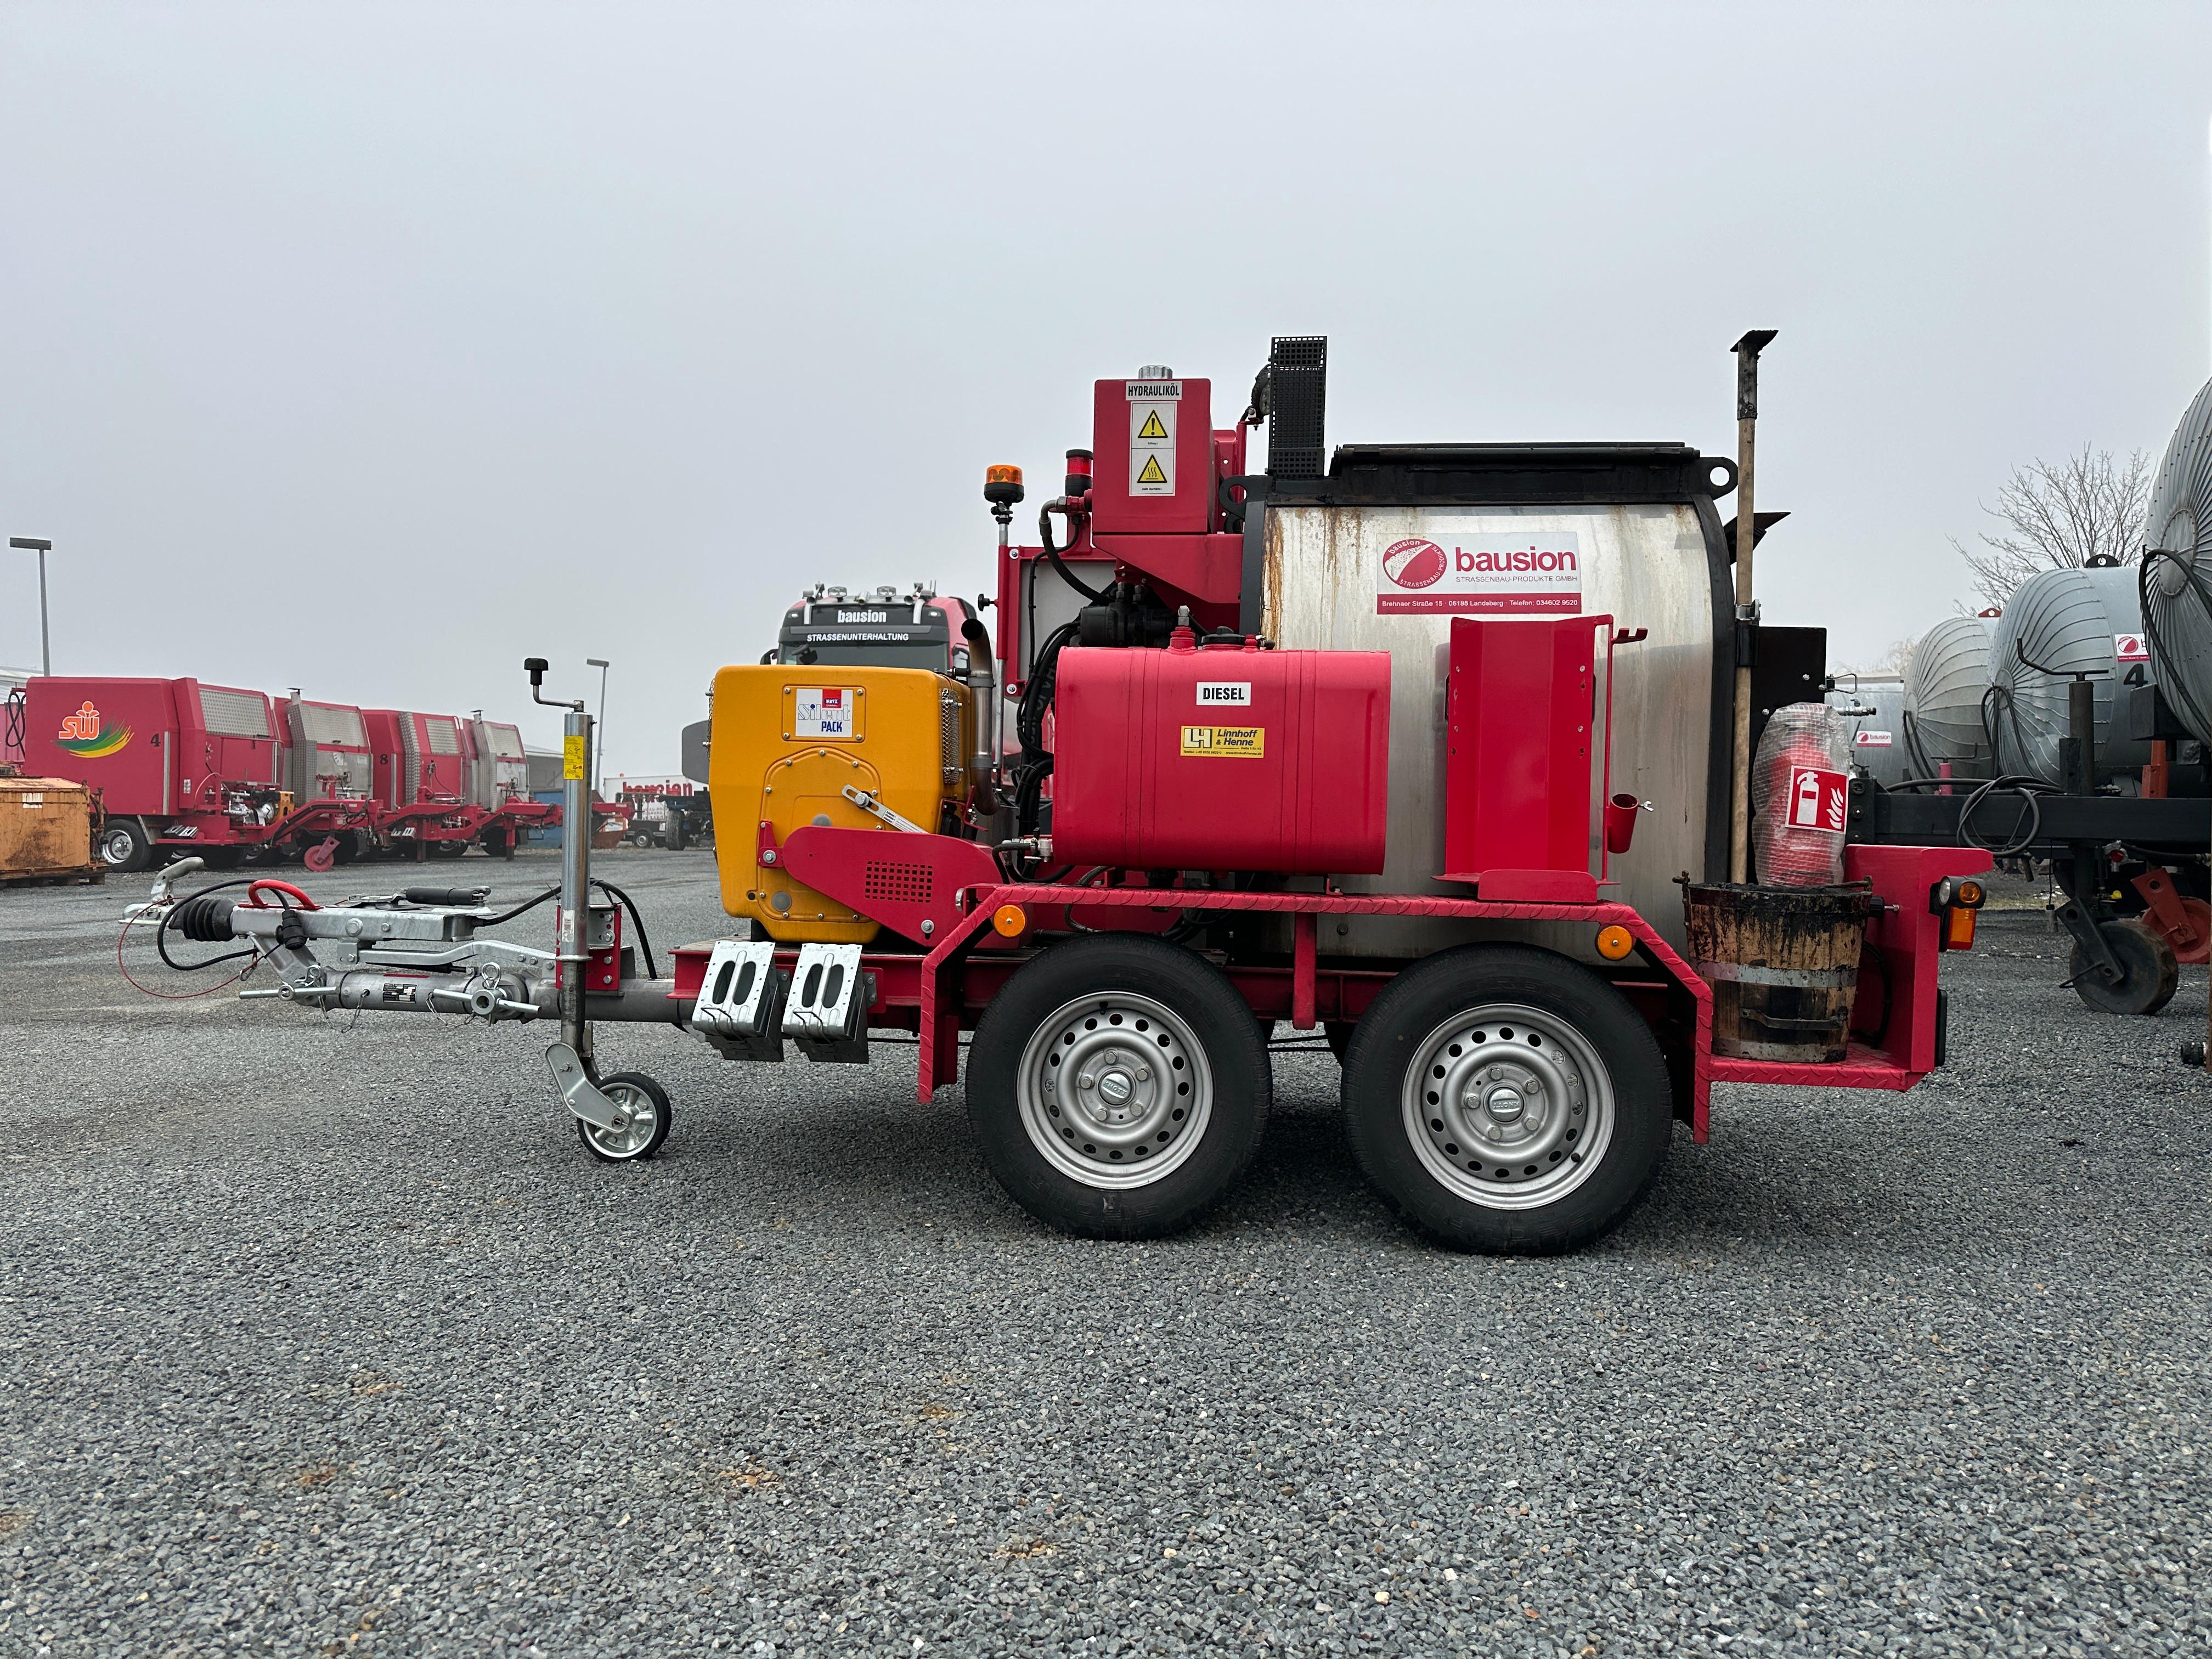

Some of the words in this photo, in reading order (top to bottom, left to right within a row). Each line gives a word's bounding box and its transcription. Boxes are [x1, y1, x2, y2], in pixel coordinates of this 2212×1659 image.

[1128, 382, 1180, 396] HYDRAULIKÖL
[1388, 540, 1420, 554] bausion
[1455, 546, 1577, 572] bausion
[1399, 546, 1445, 587] STRASSENBAU-PRODUKTE
[837, 610, 887, 623] bausion
[806, 633, 909, 642] STRASSENUNTERHALTUNG
[2123, 663, 2148, 689] 4
[1203, 687, 1245, 700] DIESEL
[798, 703, 850, 721] Silent
[821, 721, 843, 732] PACK
[150, 733, 161, 747] 4
[1217, 729, 1258, 738] Linnhoff
[1223, 737, 1254, 746] Henne
[380, 754, 388, 765] 8
